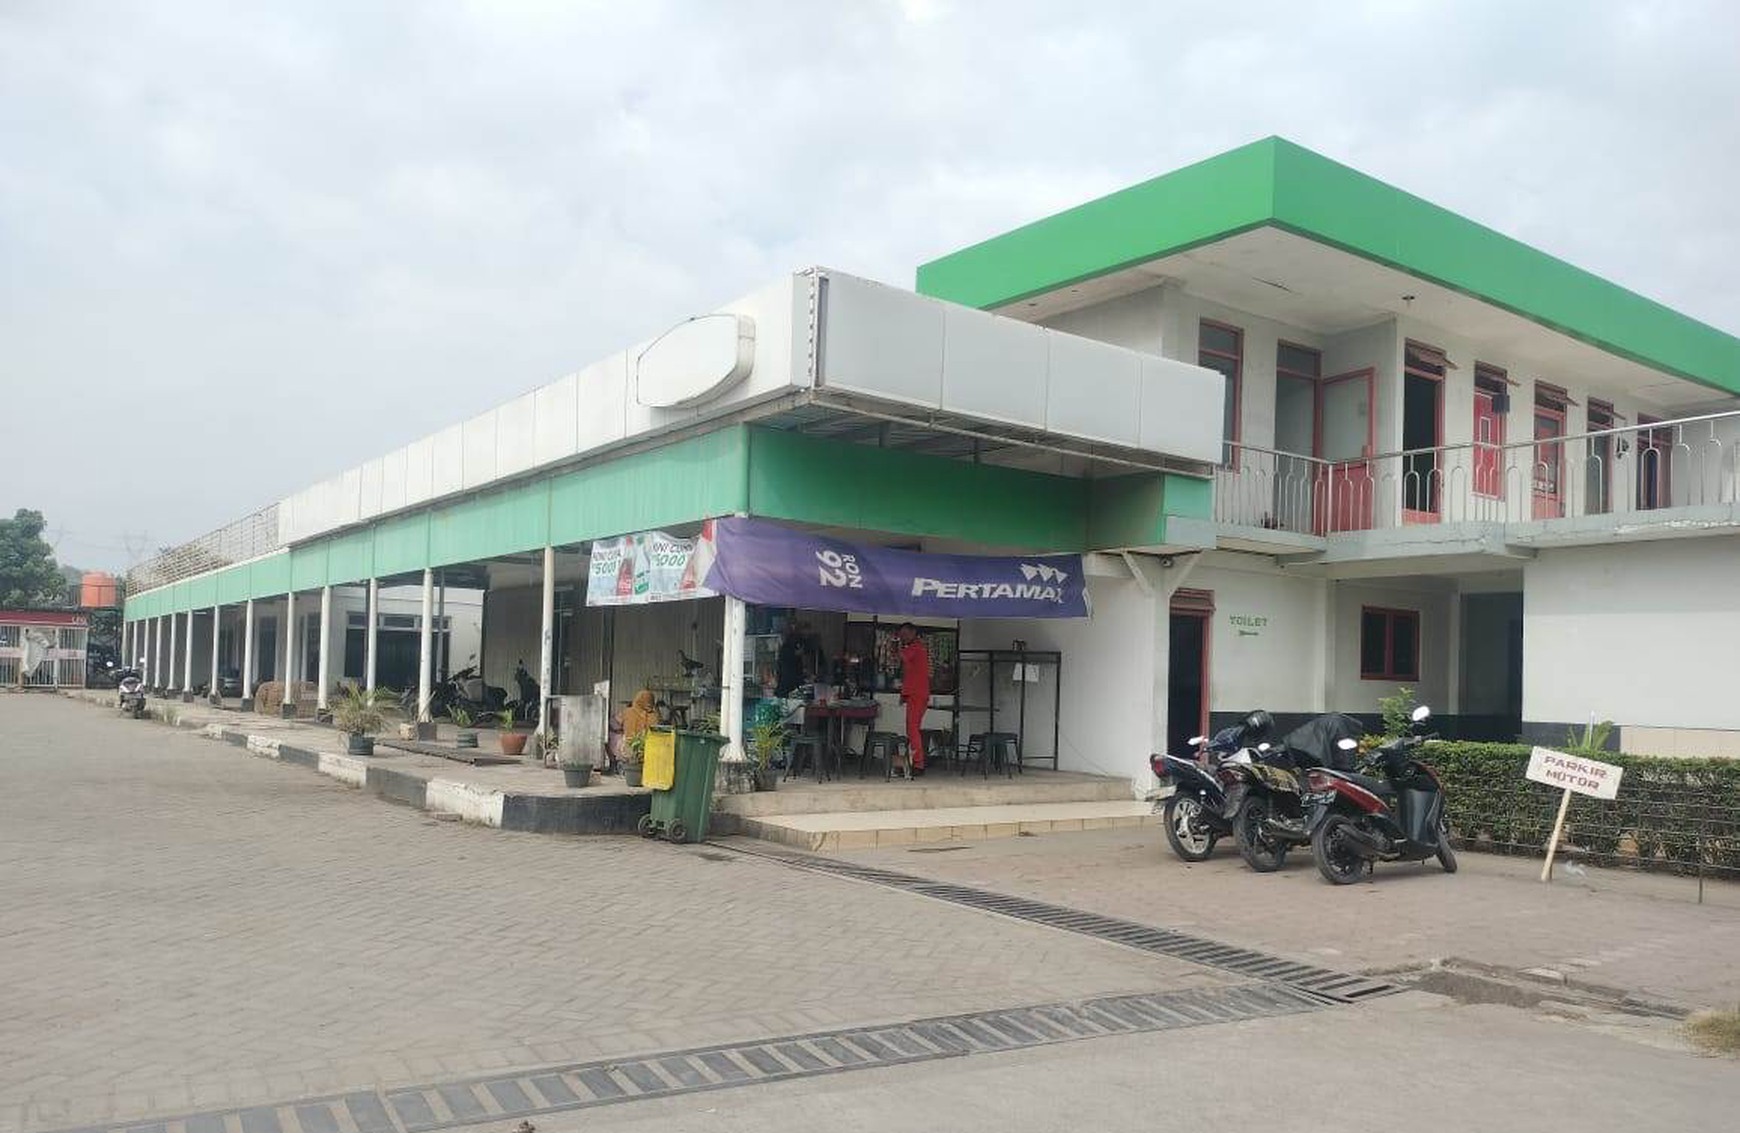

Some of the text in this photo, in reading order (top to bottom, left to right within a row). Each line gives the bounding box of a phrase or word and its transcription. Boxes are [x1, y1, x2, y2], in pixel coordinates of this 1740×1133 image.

[815, 550, 847, 587] 92
[841, 553, 863, 588] RON
[1229, 615, 1268, 626] TOILET
[1543, 756, 1607, 778] PARKIR
[1545, 769, 1600, 789] MOTOR
